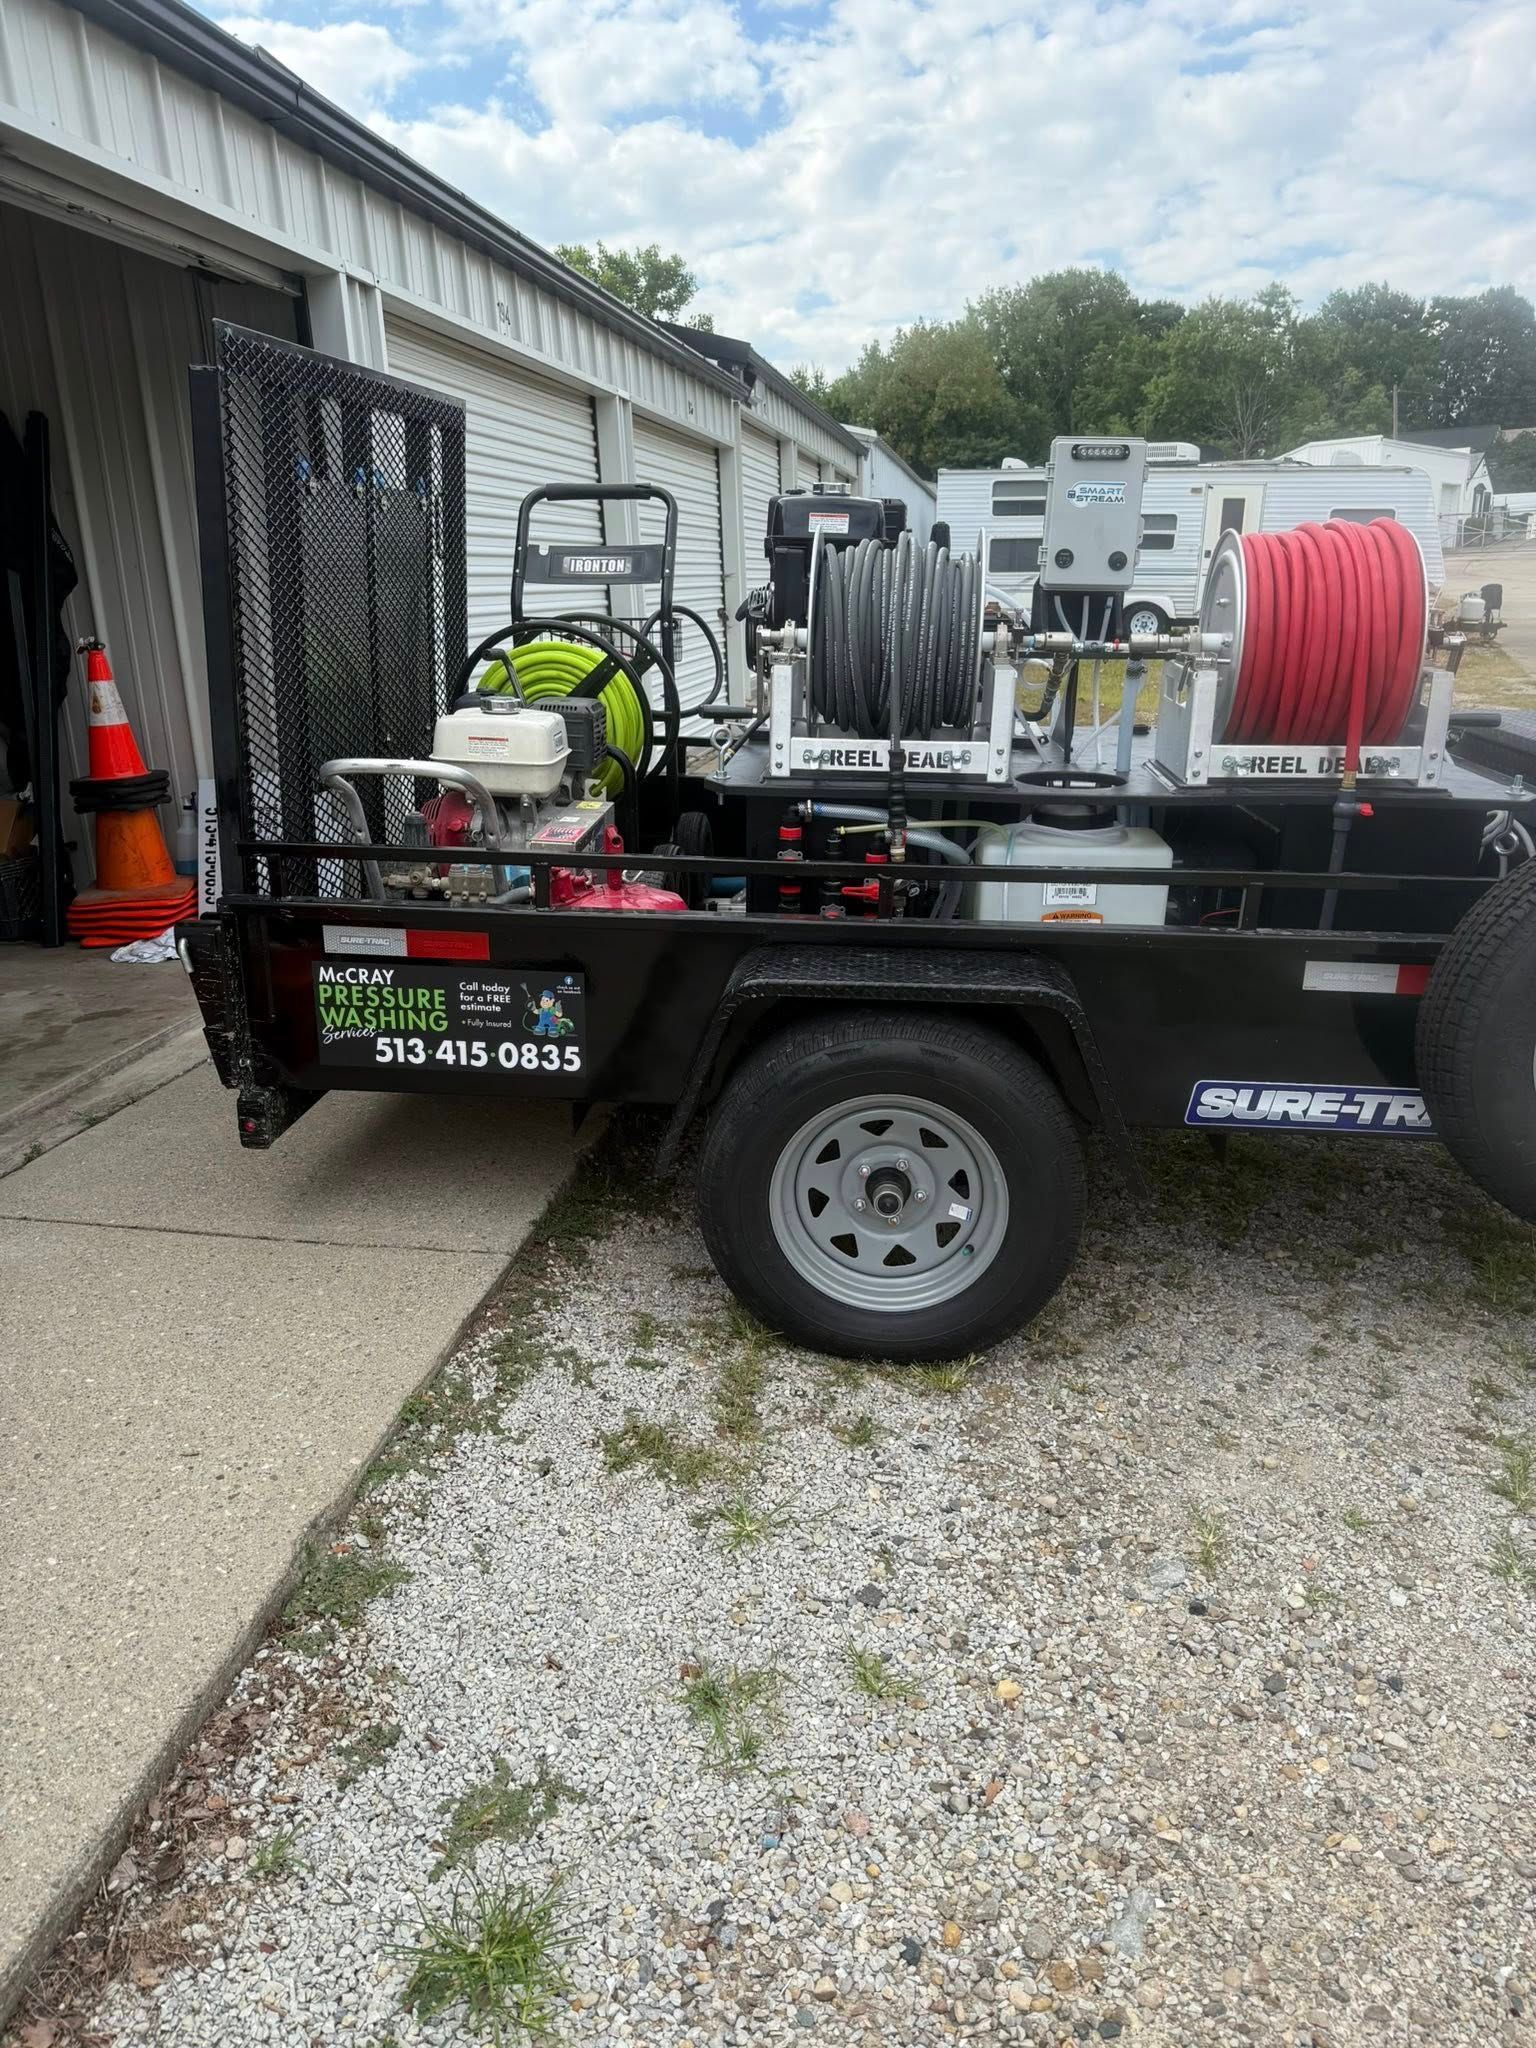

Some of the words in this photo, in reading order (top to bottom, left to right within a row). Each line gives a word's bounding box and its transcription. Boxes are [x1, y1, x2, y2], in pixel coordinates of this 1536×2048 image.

[1079, 487, 1123, 495] SMART
[1076, 495, 1125, 503] STREAM
[570, 559, 625, 572] IRONTON
[830, 750, 884, 768] REEL
[1250, 756, 1308, 774] REEL
[318, 966, 395, 985] McCRAY
[459, 981, 478, 991] Call
[481, 982, 511, 995] today
[318, 984, 446, 1010] PRESSURE
[460, 991, 474, 1001] for
[487, 994, 511, 1003] FREE
[460, 1002, 502, 1012] estimate
[319, 1006, 449, 1032] WASHING
[467, 1018, 484, 1028] Fully
[486, 1020, 512, 1028] Insured
[322, 1024, 377, 1045] Services
